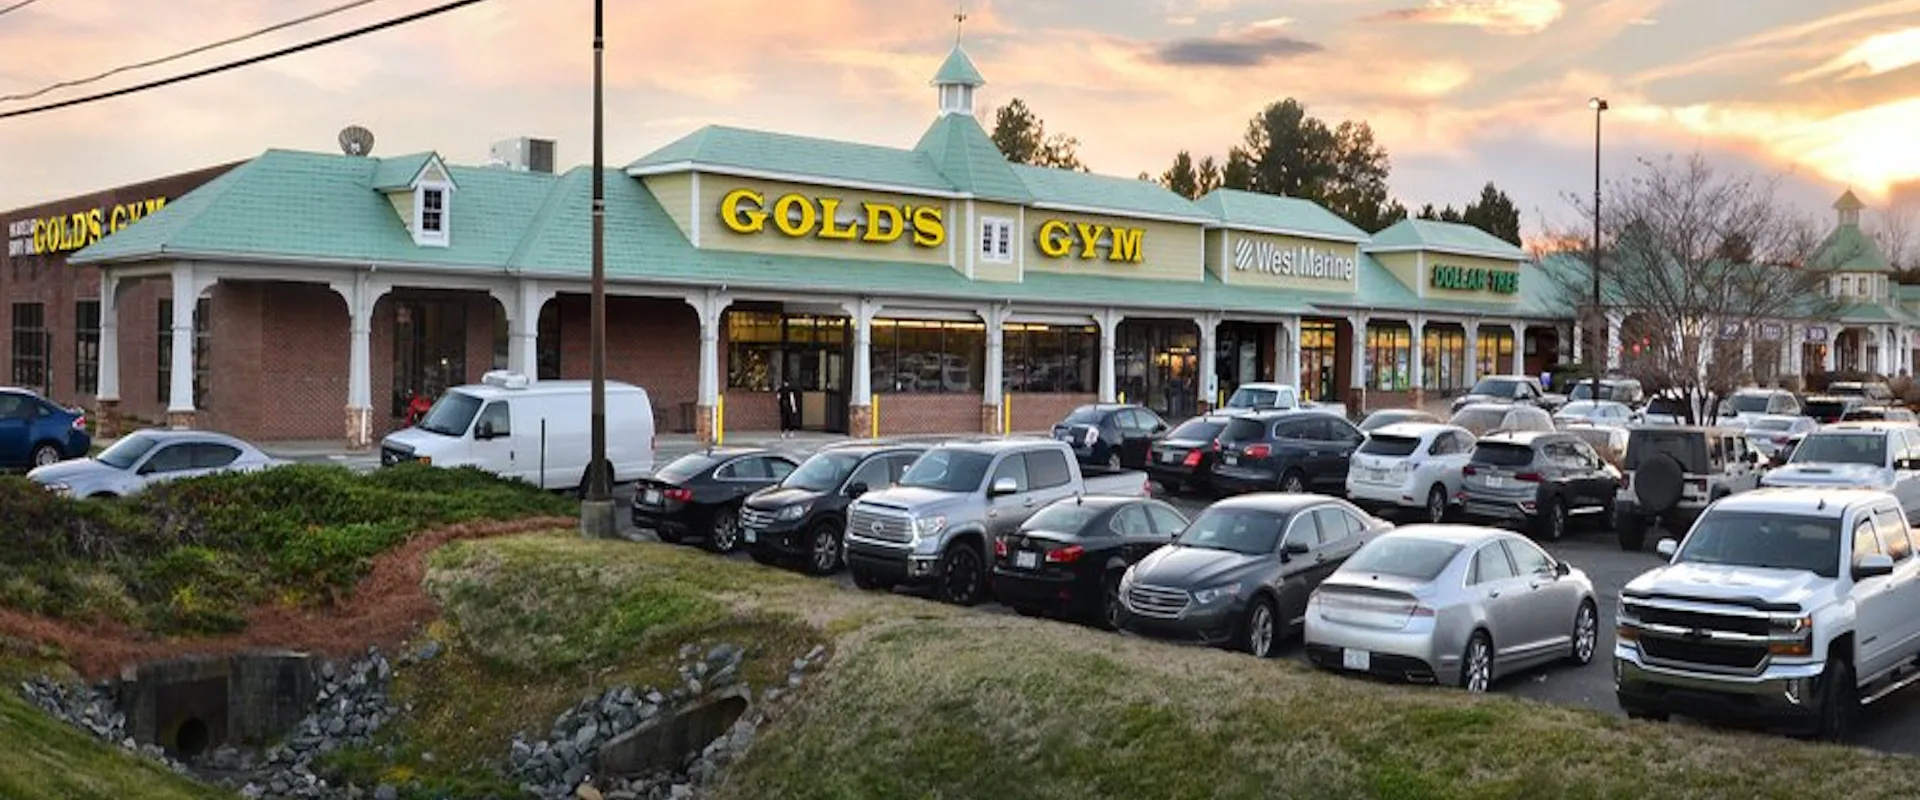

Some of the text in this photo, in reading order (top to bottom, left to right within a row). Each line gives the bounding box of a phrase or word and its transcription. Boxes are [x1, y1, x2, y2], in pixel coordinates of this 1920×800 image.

[33, 208, 103, 255] GOLD'S
[720, 188, 1144, 264] GOLD'S GYM
[1255, 241, 1354, 281] West Marine
[1435, 265, 1520, 295] DOLLAR TREE
